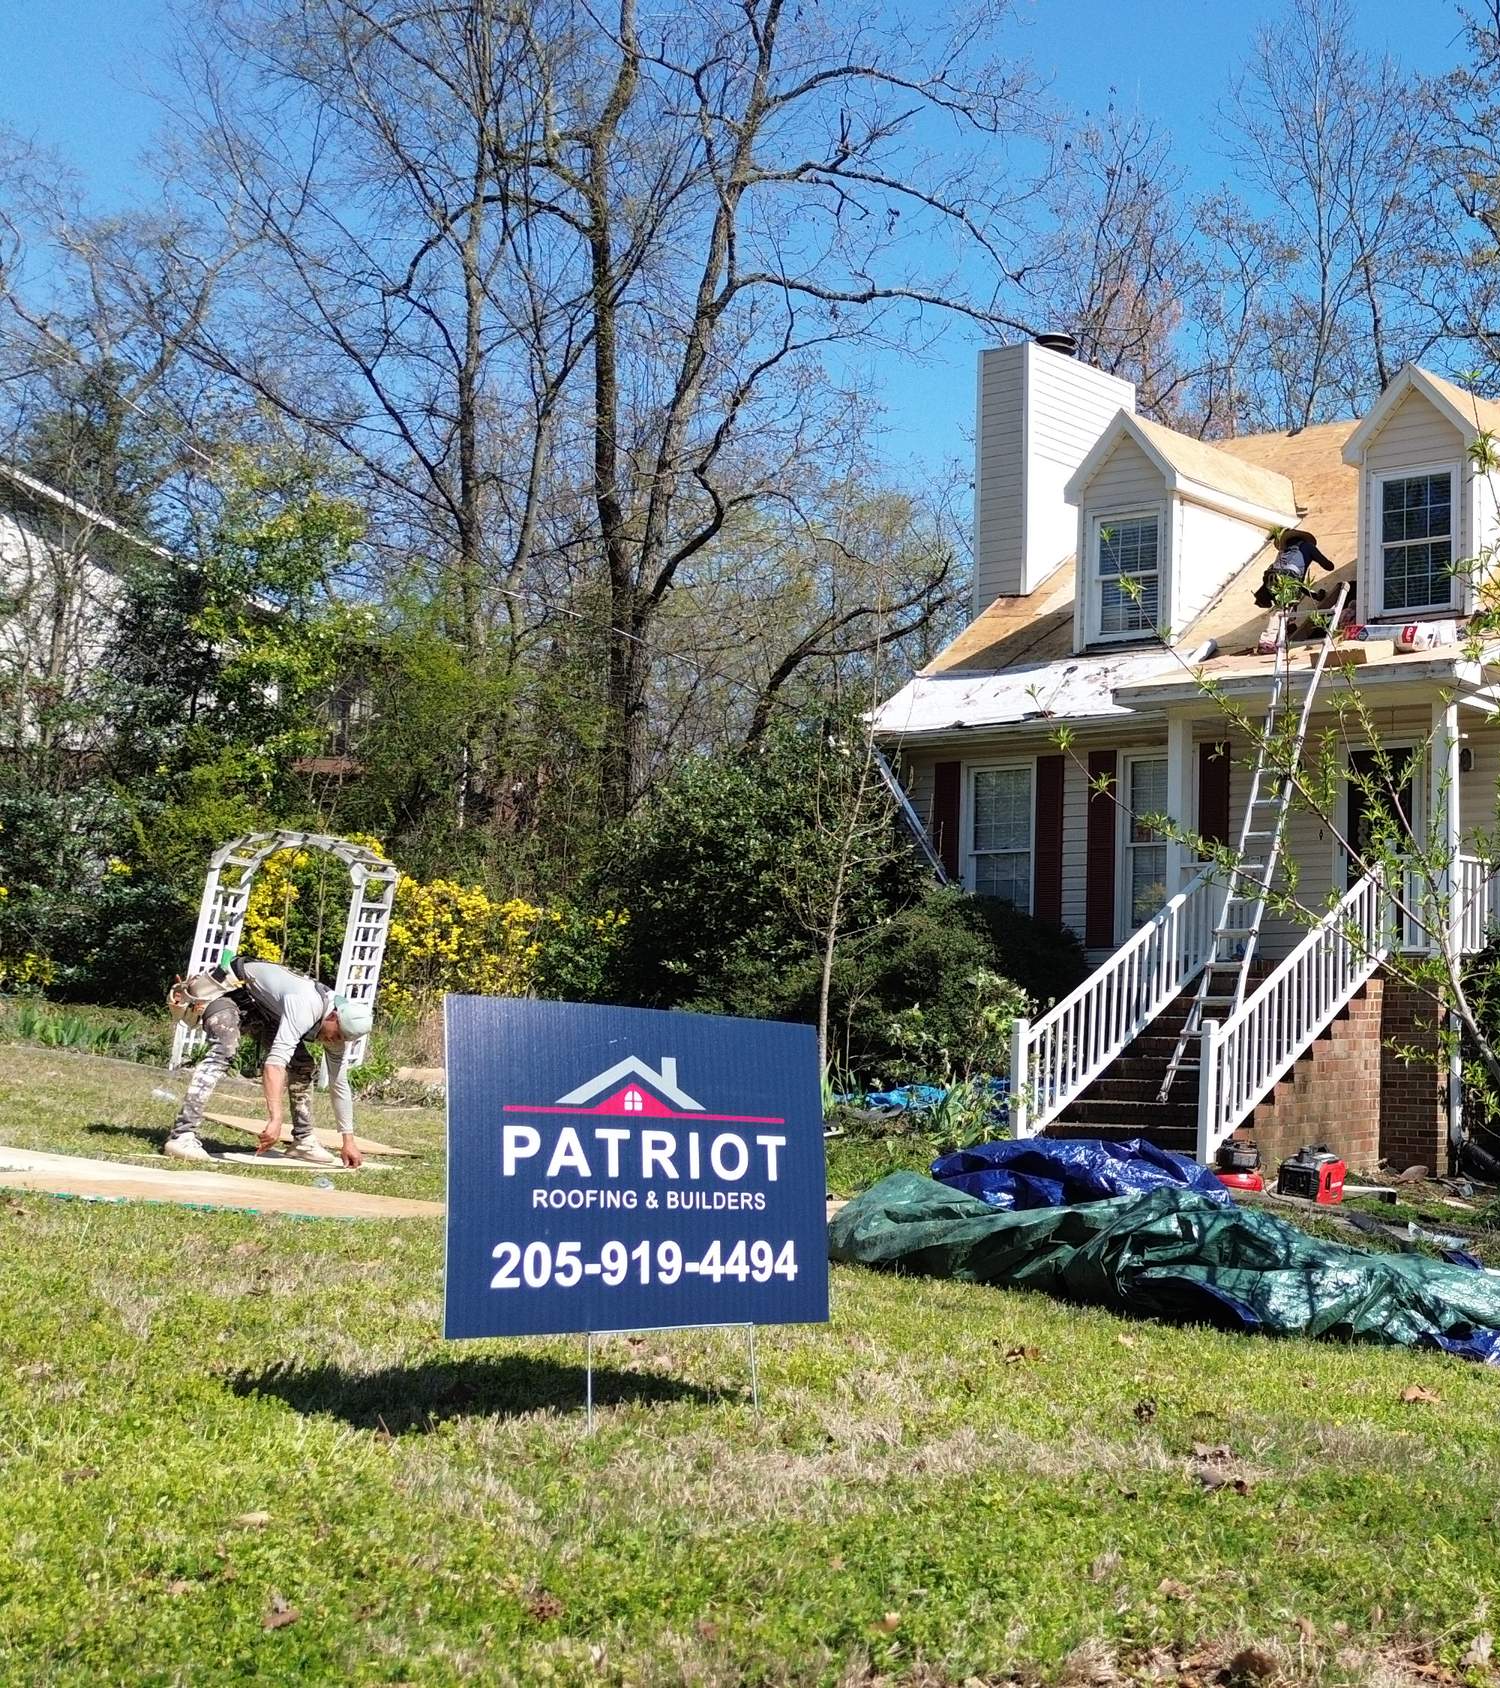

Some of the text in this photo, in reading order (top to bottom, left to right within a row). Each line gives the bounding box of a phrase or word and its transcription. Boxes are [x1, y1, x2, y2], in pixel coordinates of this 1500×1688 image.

[502, 1125, 787, 1182] PATRIOT
[532, 1189, 766, 1211] ROOFING & BUILDERS
[490, 1239, 799, 1290] 205-919-4494
